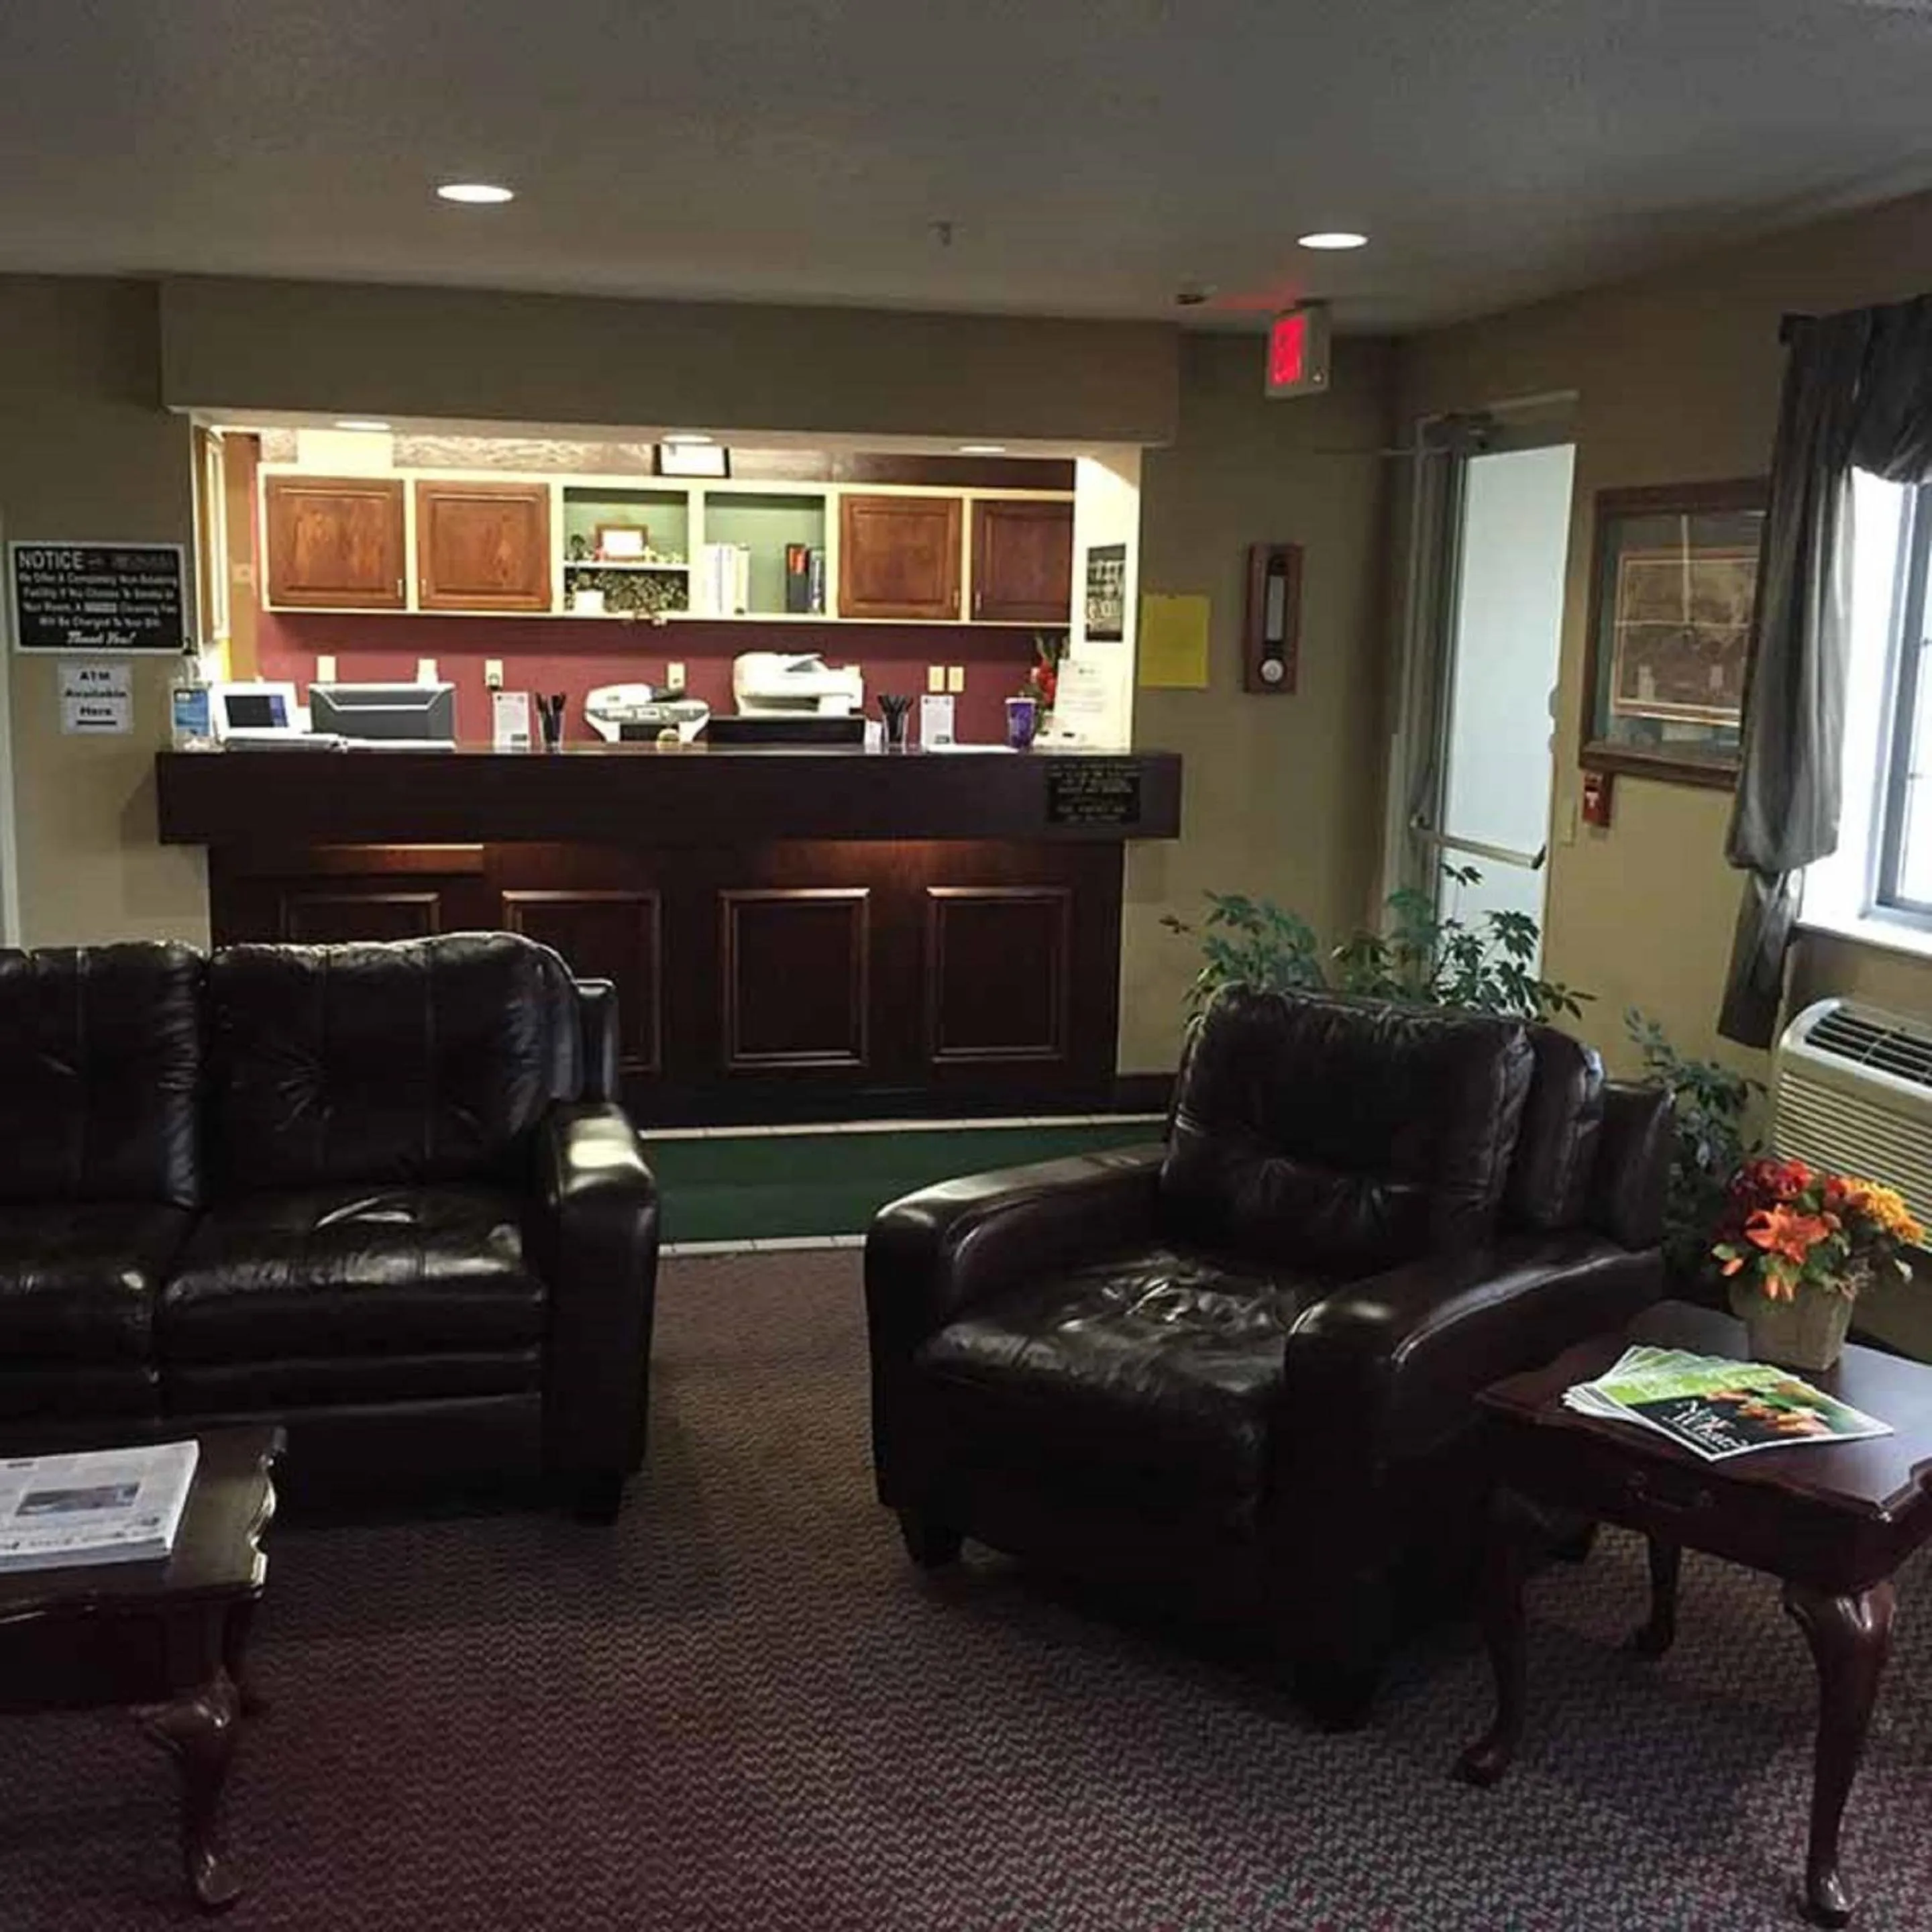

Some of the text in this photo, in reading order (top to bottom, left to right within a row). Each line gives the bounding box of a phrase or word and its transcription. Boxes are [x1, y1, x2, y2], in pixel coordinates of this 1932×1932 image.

[19, 550, 85, 570] NOTICE
[80, 671, 111, 682] ATM
[80, 706, 112, 716] Here
